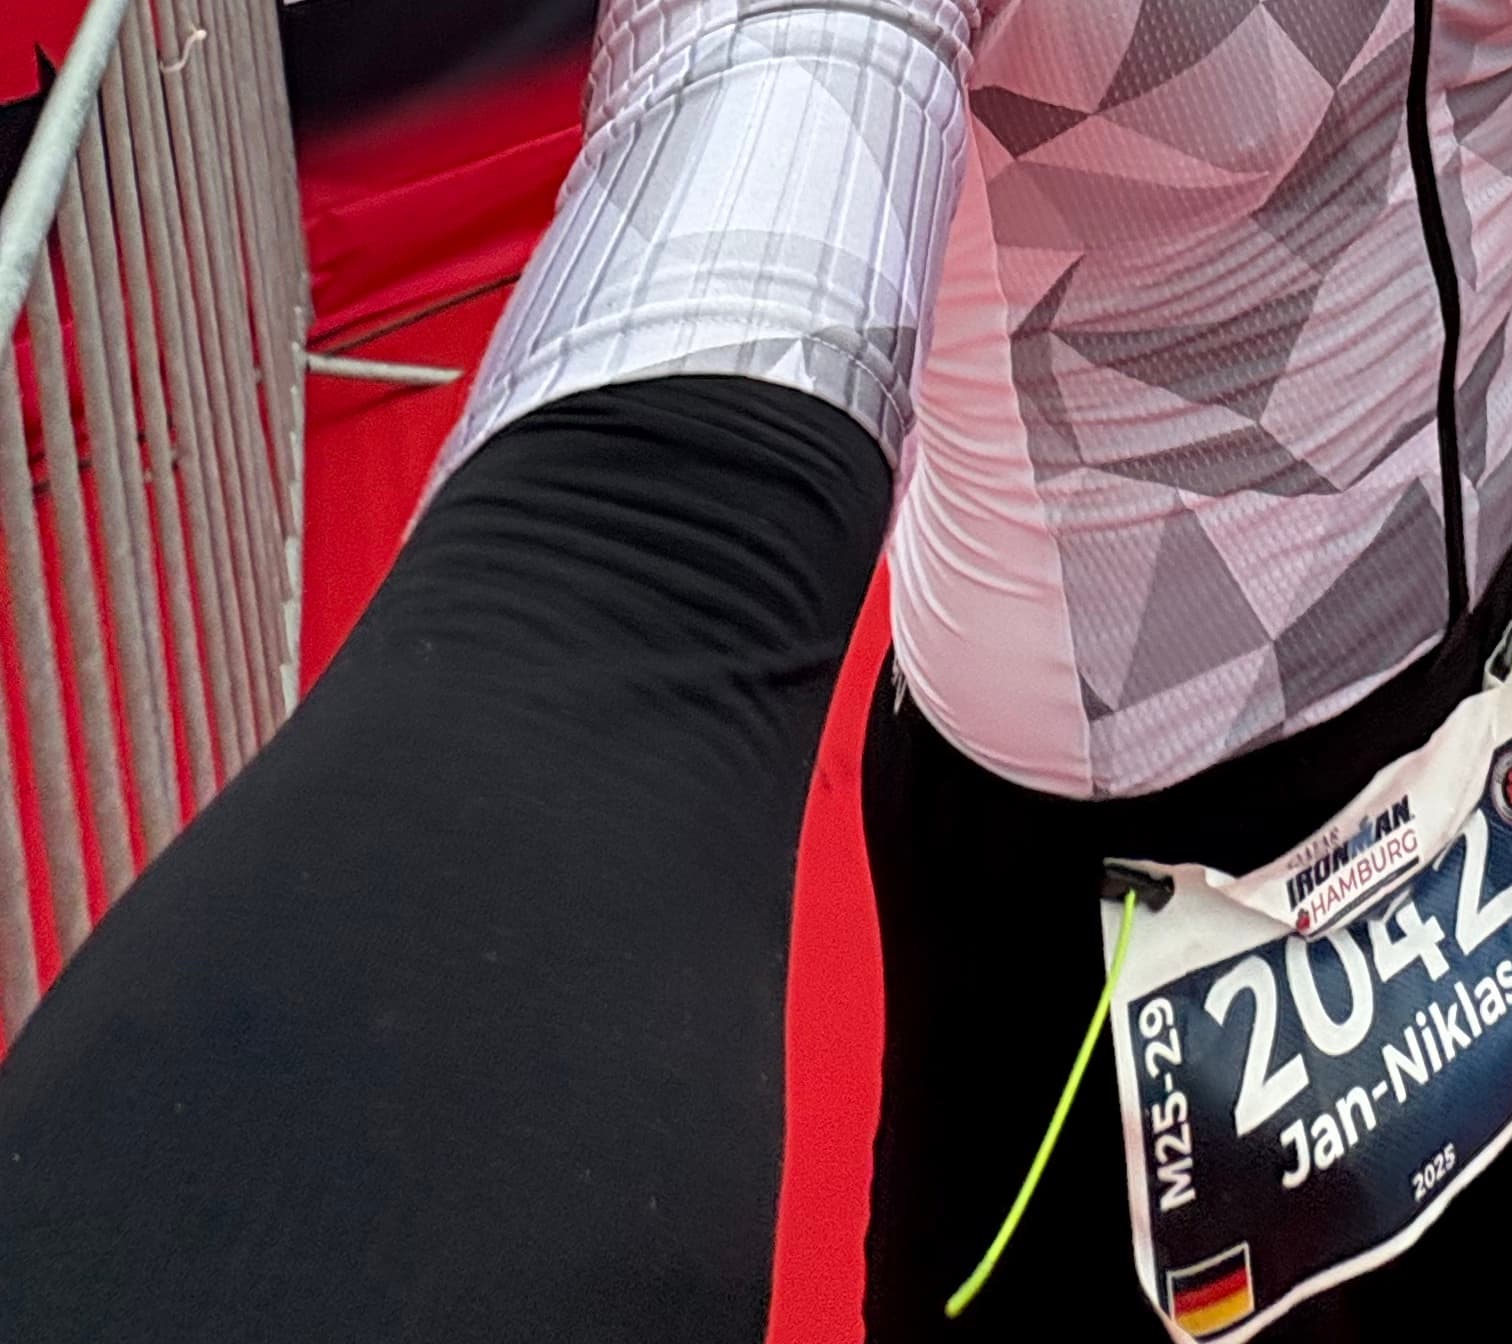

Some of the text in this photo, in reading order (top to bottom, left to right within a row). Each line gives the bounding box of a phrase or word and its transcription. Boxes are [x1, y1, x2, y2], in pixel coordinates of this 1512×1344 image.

[1286, 794, 1415, 912] IRONMAN
[1311, 828, 1418, 922] HAMBURG
[1138, 996, 1196, 1212] M25-29
[1411, 1143, 1457, 1202] 2025
